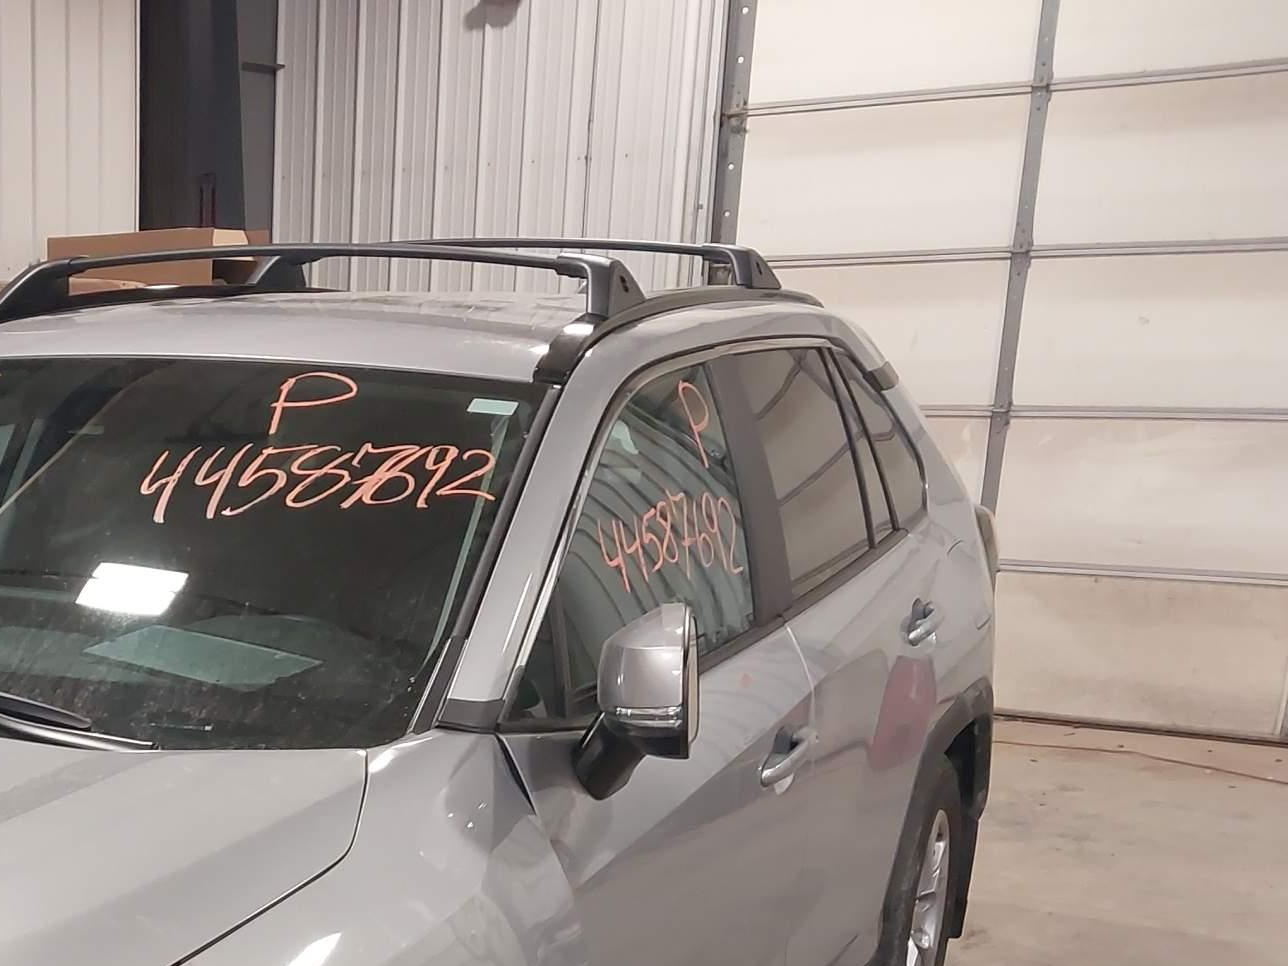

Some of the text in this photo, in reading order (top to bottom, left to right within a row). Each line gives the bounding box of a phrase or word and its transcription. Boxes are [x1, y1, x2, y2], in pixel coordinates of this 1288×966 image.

[268, 371, 359, 435] P
[678, 380, 710, 468] P
[140, 442, 496, 524] 44587692
[597, 489, 744, 593] 44587692
